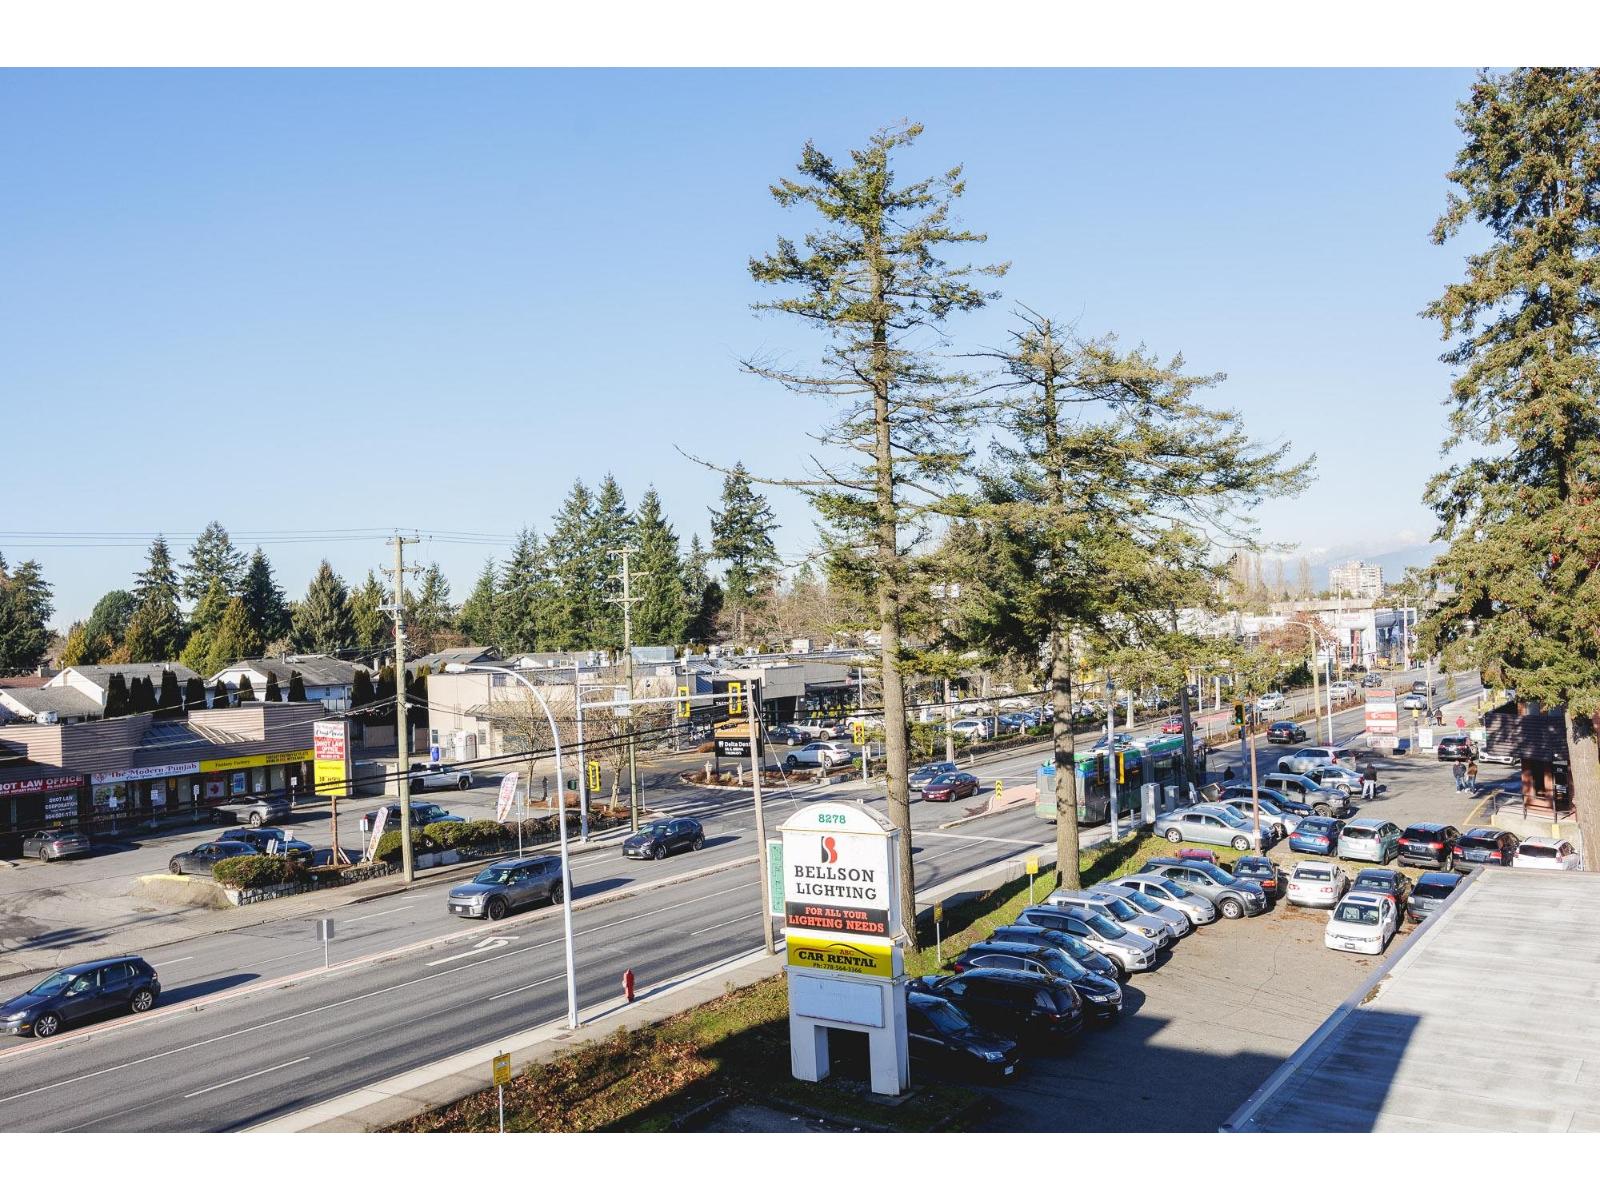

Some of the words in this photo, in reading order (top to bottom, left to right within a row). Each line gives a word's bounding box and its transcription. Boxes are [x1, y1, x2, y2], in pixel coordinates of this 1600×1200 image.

[168, 763, 197, 772] Punjab
[0, 782, 17, 790] OT
[20, 780, 43, 788] LAW
[46, 776, 82, 785] OFFICE
[818, 814, 846, 824] 8278
[794, 865, 874, 883] BELLSON
[796, 883, 877, 900] LIGHTING
[805, 906, 823, 916] FOR
[825, 908, 842, 917] ALL
[842, 910, 868, 920] YOUR
[788, 915, 843, 929] LIGHTING
[846, 920, 885, 933] NEEDS
[798, 951, 824, 961] CAR
[827, 954, 877, 968] RENTAL
